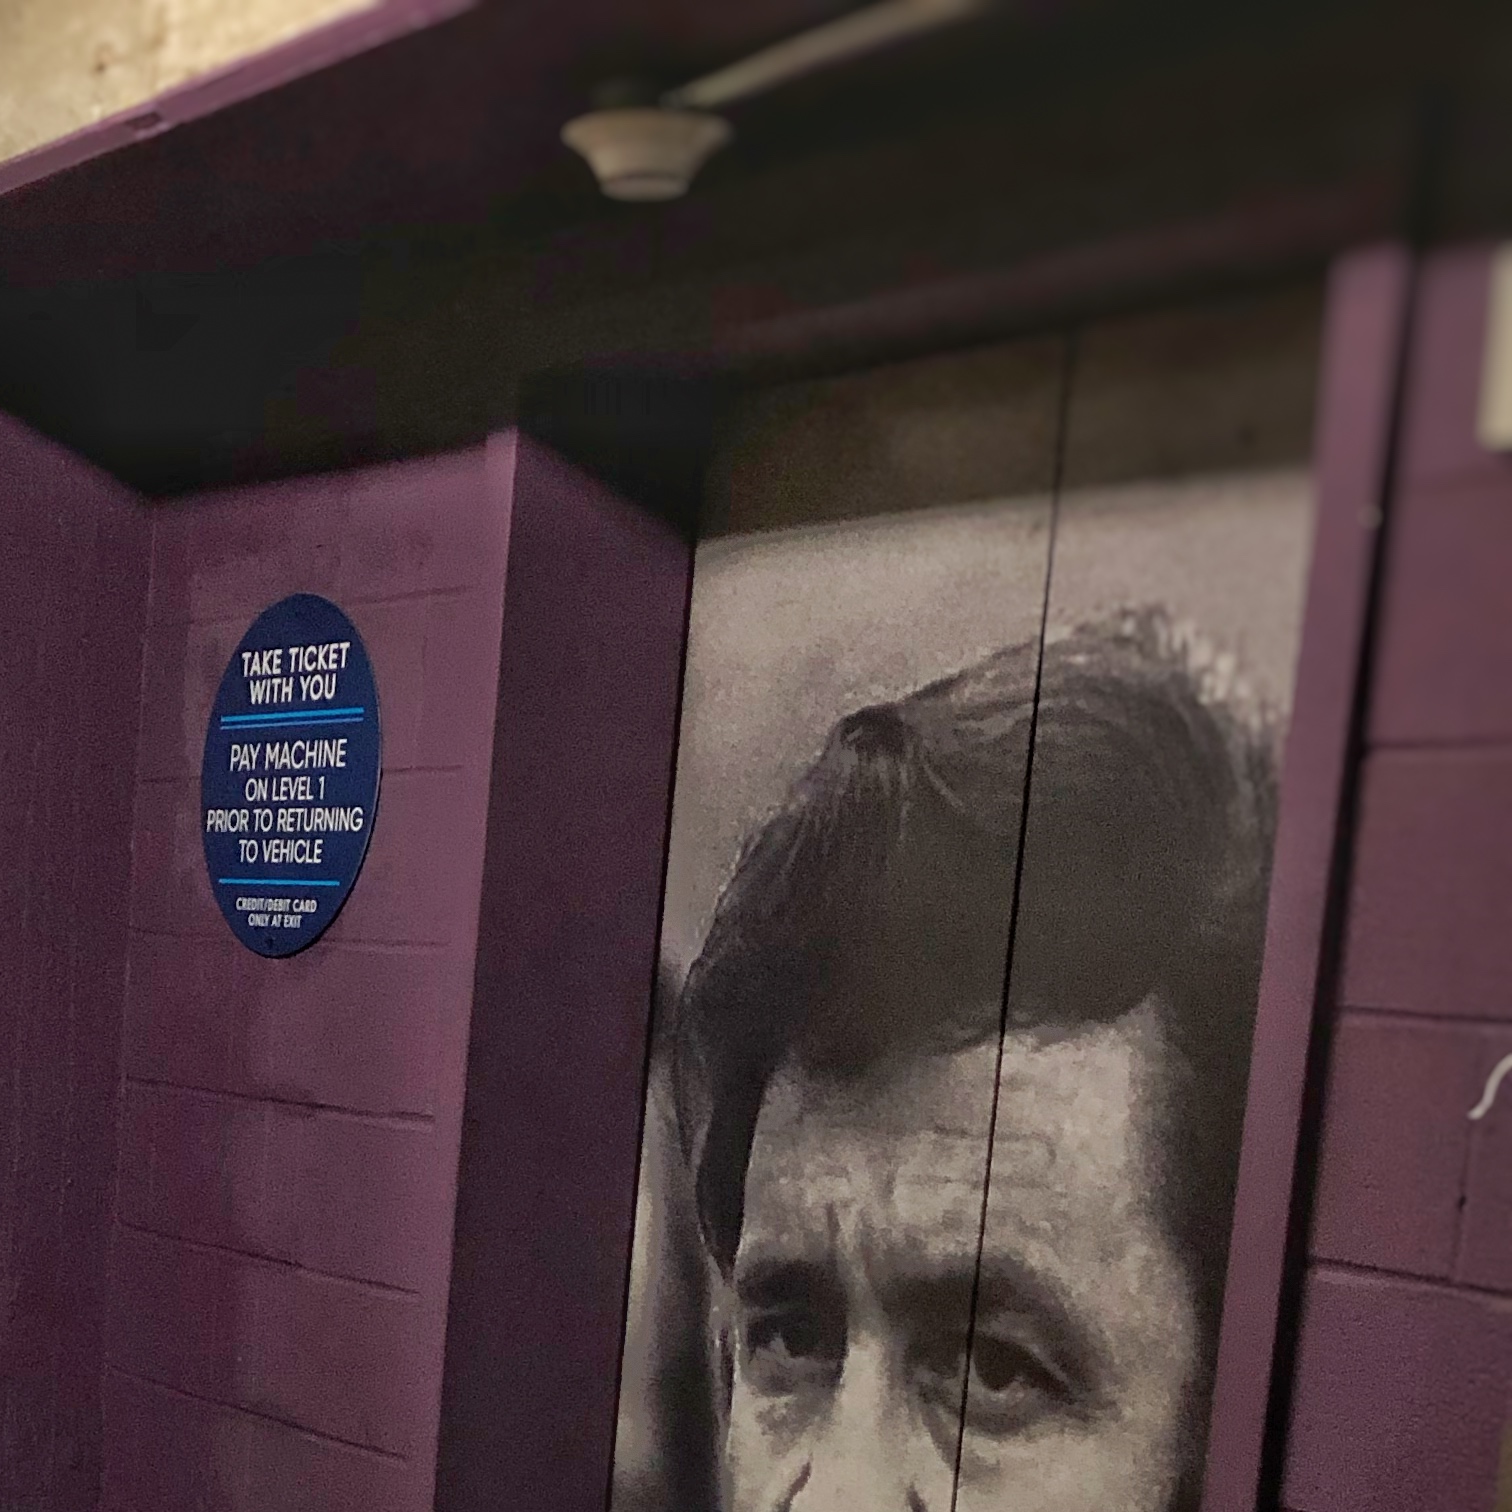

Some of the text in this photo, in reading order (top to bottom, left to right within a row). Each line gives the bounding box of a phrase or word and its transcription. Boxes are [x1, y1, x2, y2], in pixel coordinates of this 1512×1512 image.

[242, 642, 350, 677] TAKE TICKET
[249, 673, 337, 705] WITH YOU
[230, 739, 347, 771] PAY MACHINE
[245, 776, 325, 801] ON LEVEL 1
[206, 807, 364, 833] PRIOR TO RETURNING
[239, 839, 323, 864] TO VEHICLE
[236, 897, 317, 913] CREDIT/DEBIT CARD
[248, 913, 302, 928] ONLY AT EXIT
